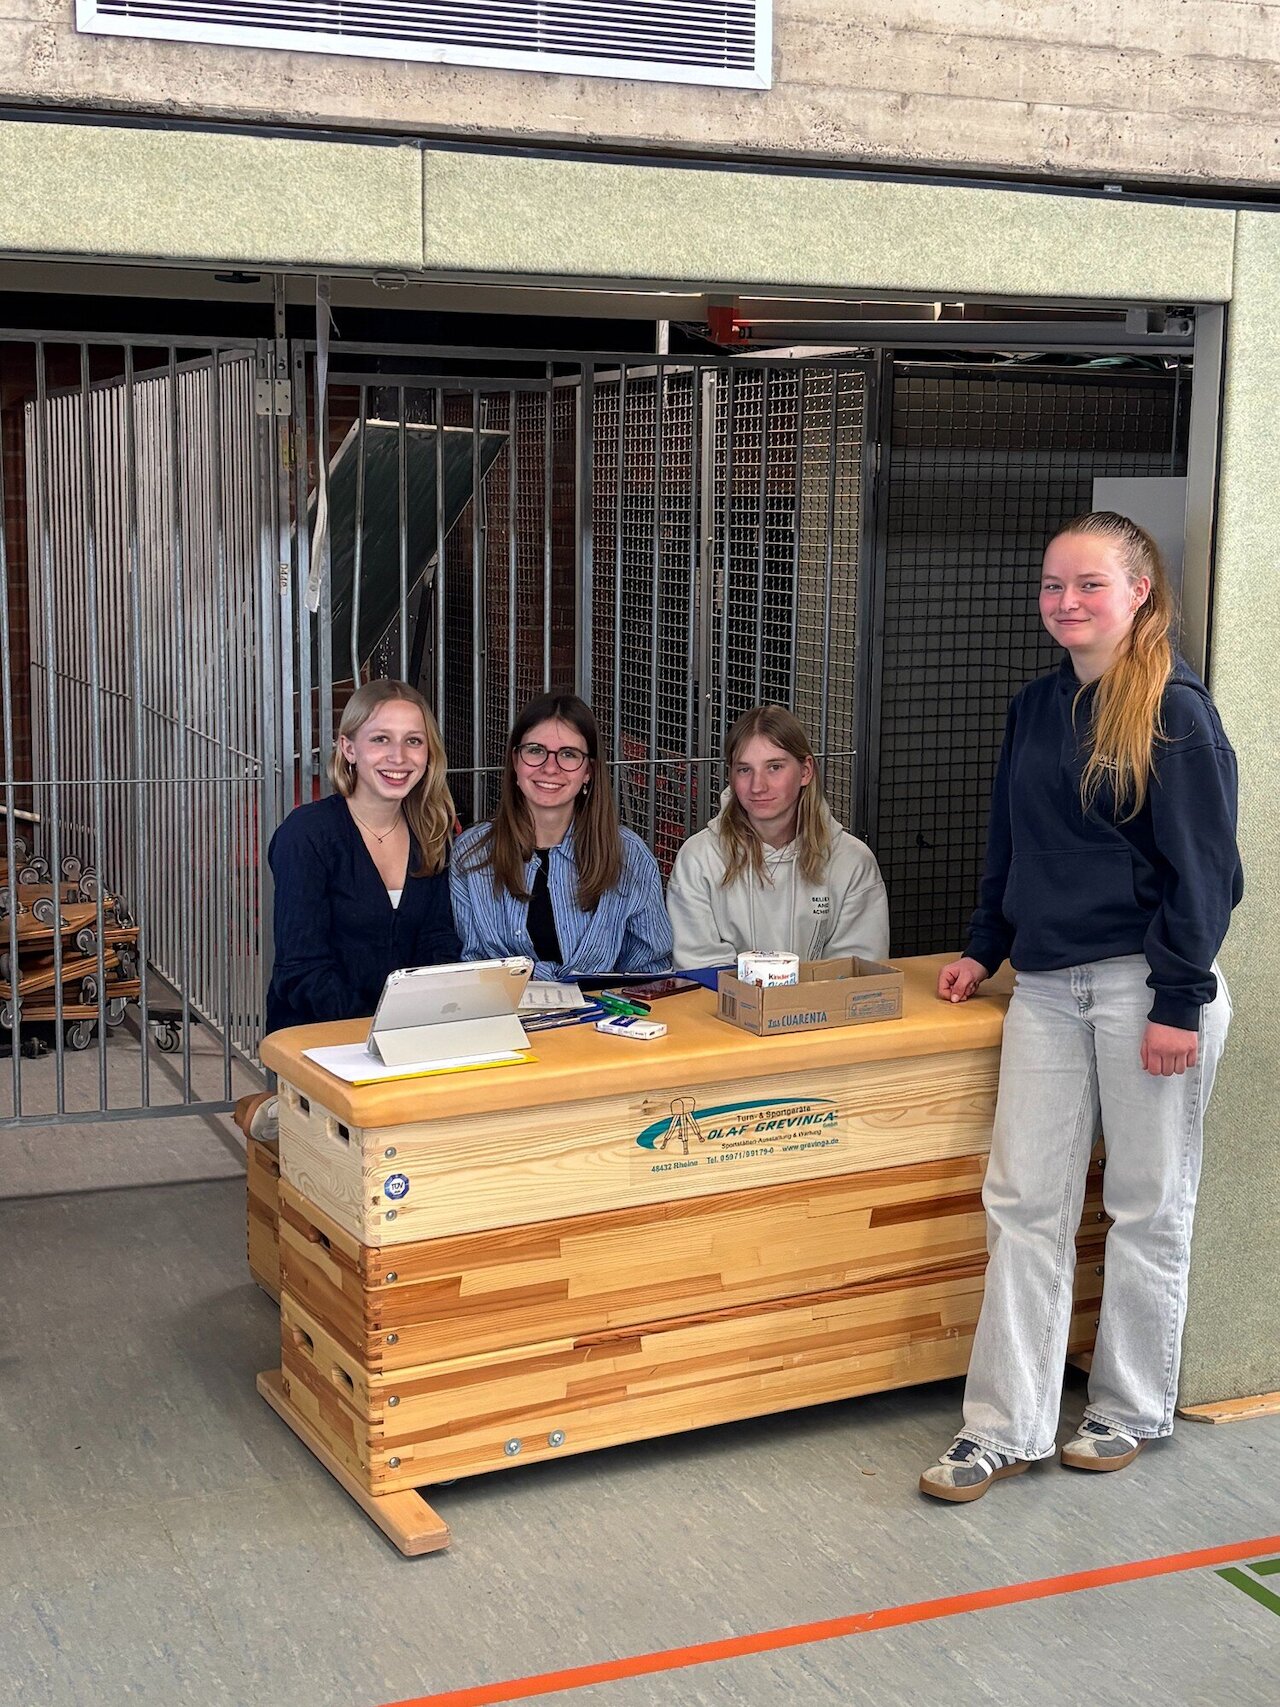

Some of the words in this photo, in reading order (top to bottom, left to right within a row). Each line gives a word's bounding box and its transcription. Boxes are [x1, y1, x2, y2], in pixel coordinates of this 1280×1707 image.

[781, 1011, 827, 1027] CUARENTA
[707, 1124, 749, 1140] OLAF
[755, 1111, 836, 1132] GREVINGA
[737, 1113, 757, 1122] Turn-
[651, 1163, 672, 1173] 48432
[673, 1160, 698, 1170] Rheine
[706, 1155, 719, 1165] Tel.
[782, 1138, 839, 1152] www.grevinga.de
